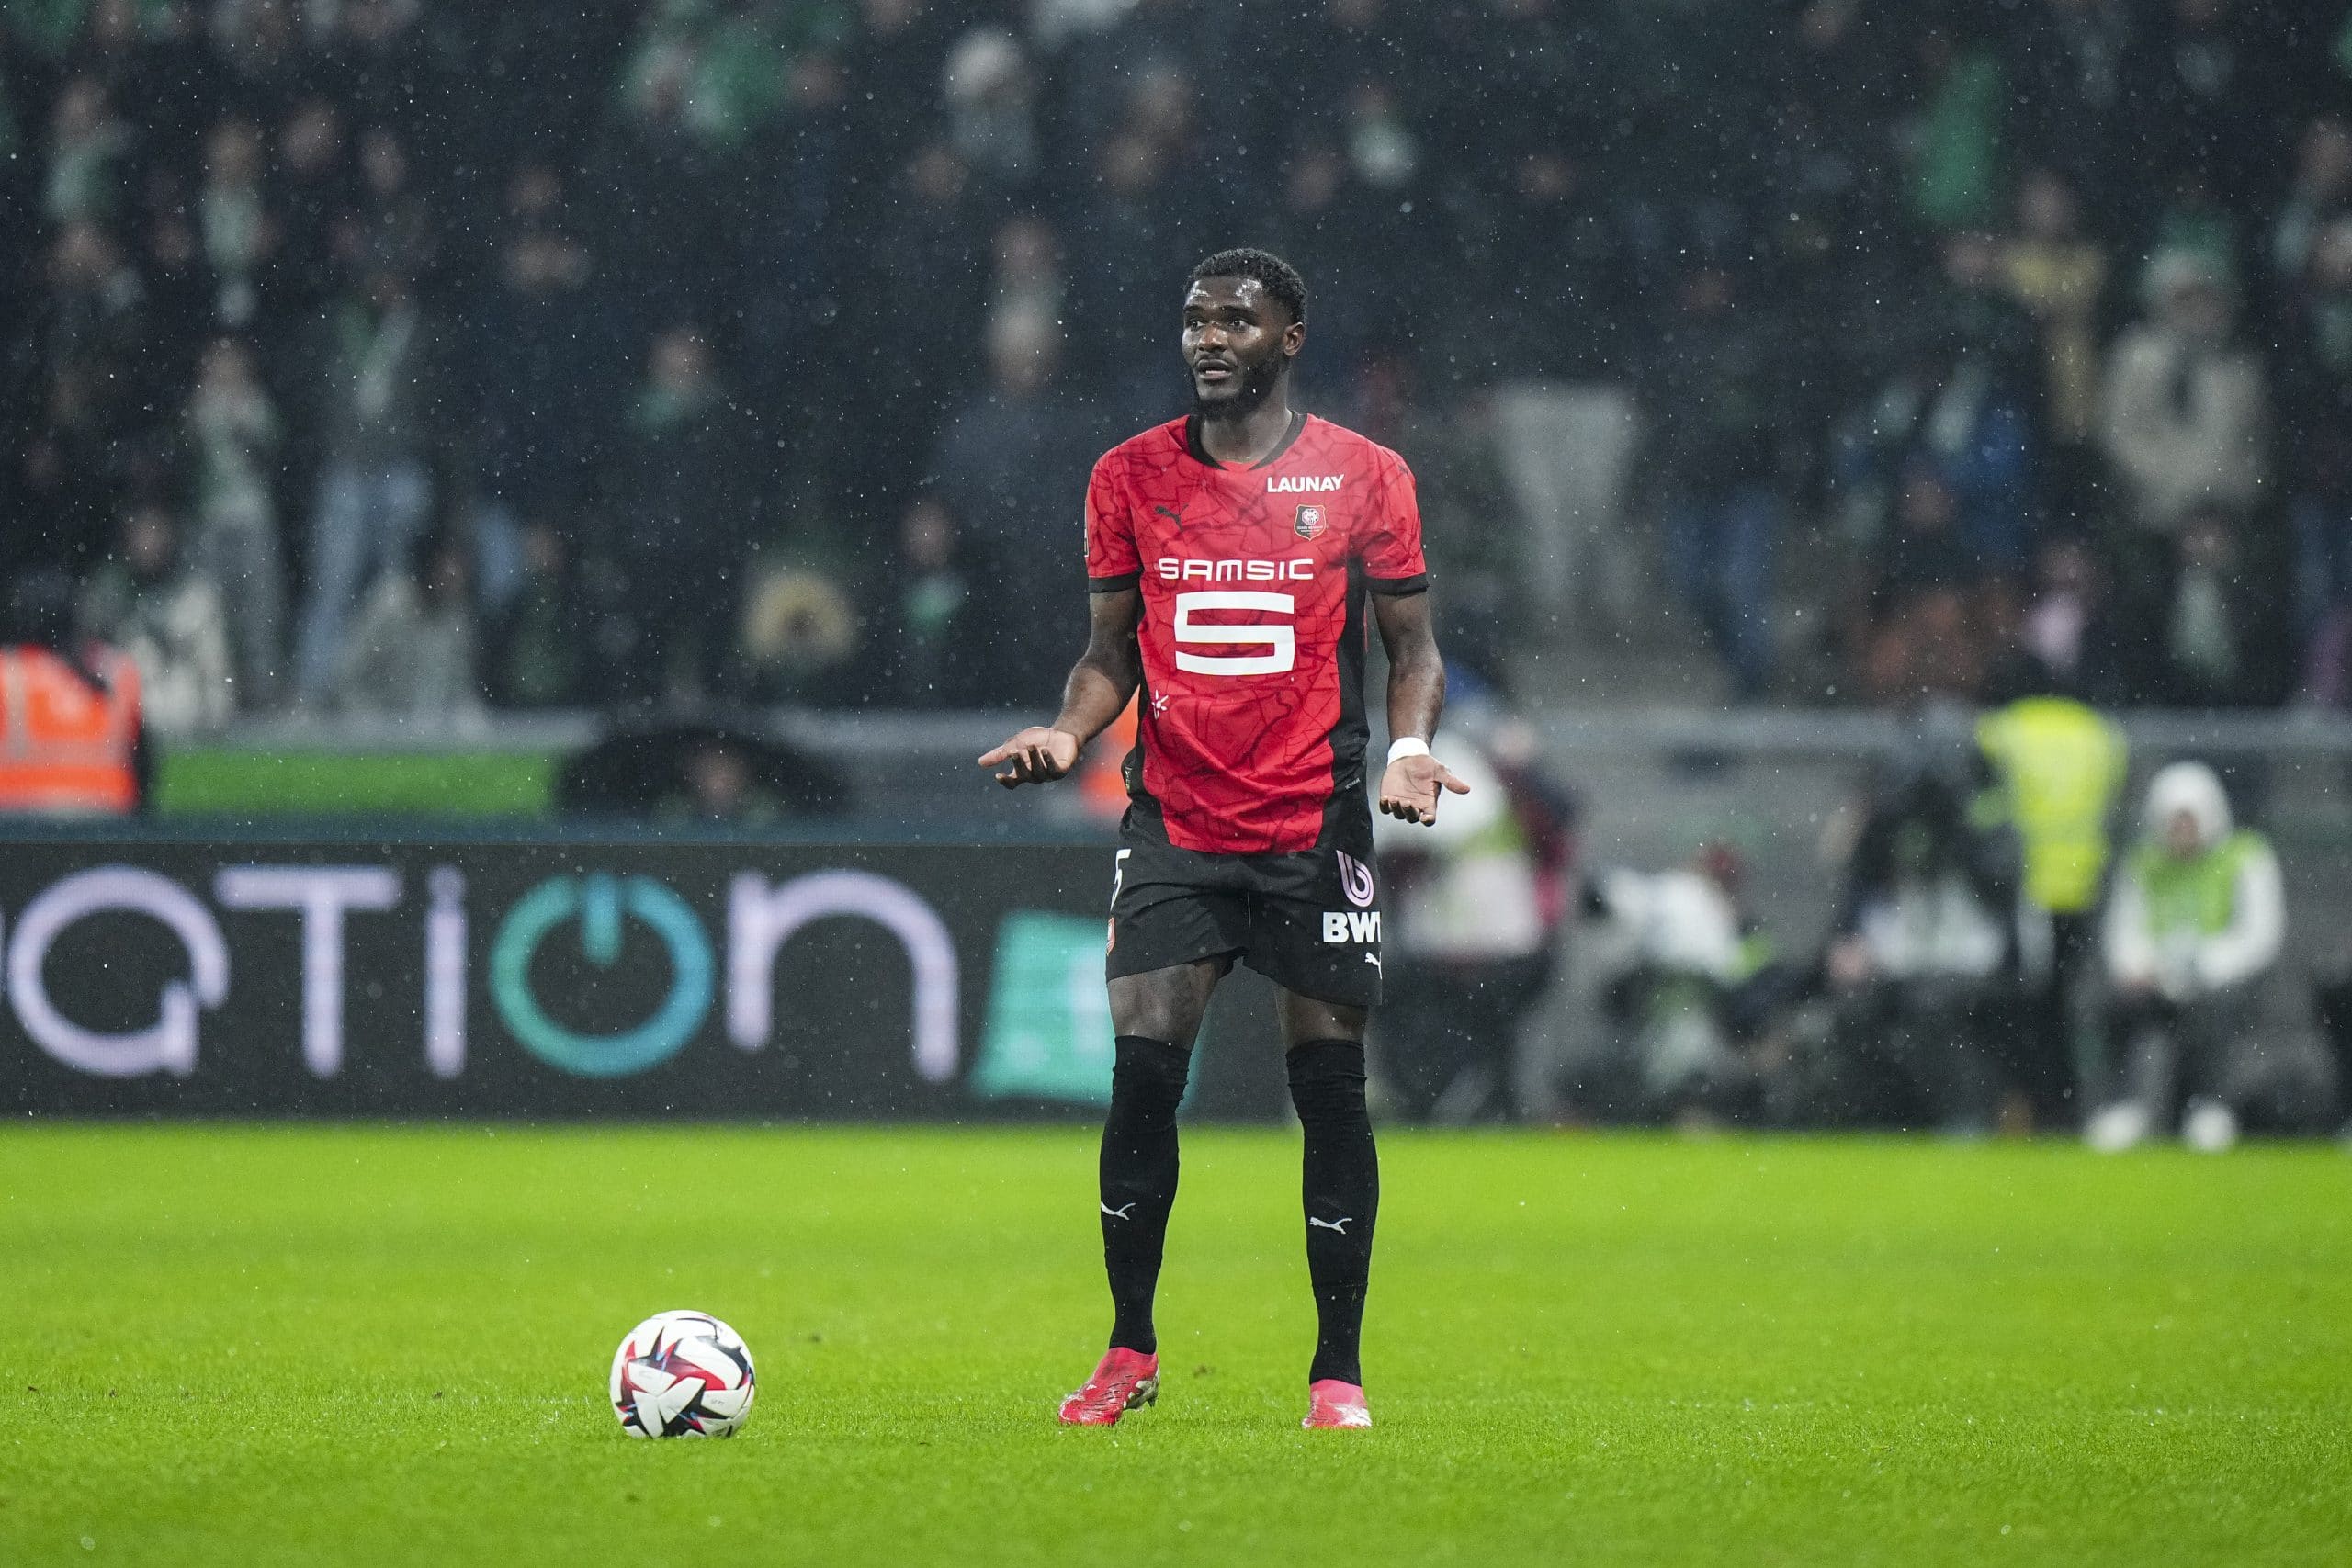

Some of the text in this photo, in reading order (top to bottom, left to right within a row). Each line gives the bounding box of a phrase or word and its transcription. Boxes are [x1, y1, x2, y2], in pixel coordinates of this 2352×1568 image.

[1267, 473, 1344, 493] LAUNAY
[1159, 558, 1314, 581] SAMSIC
[1322, 911, 1382, 943] BW
